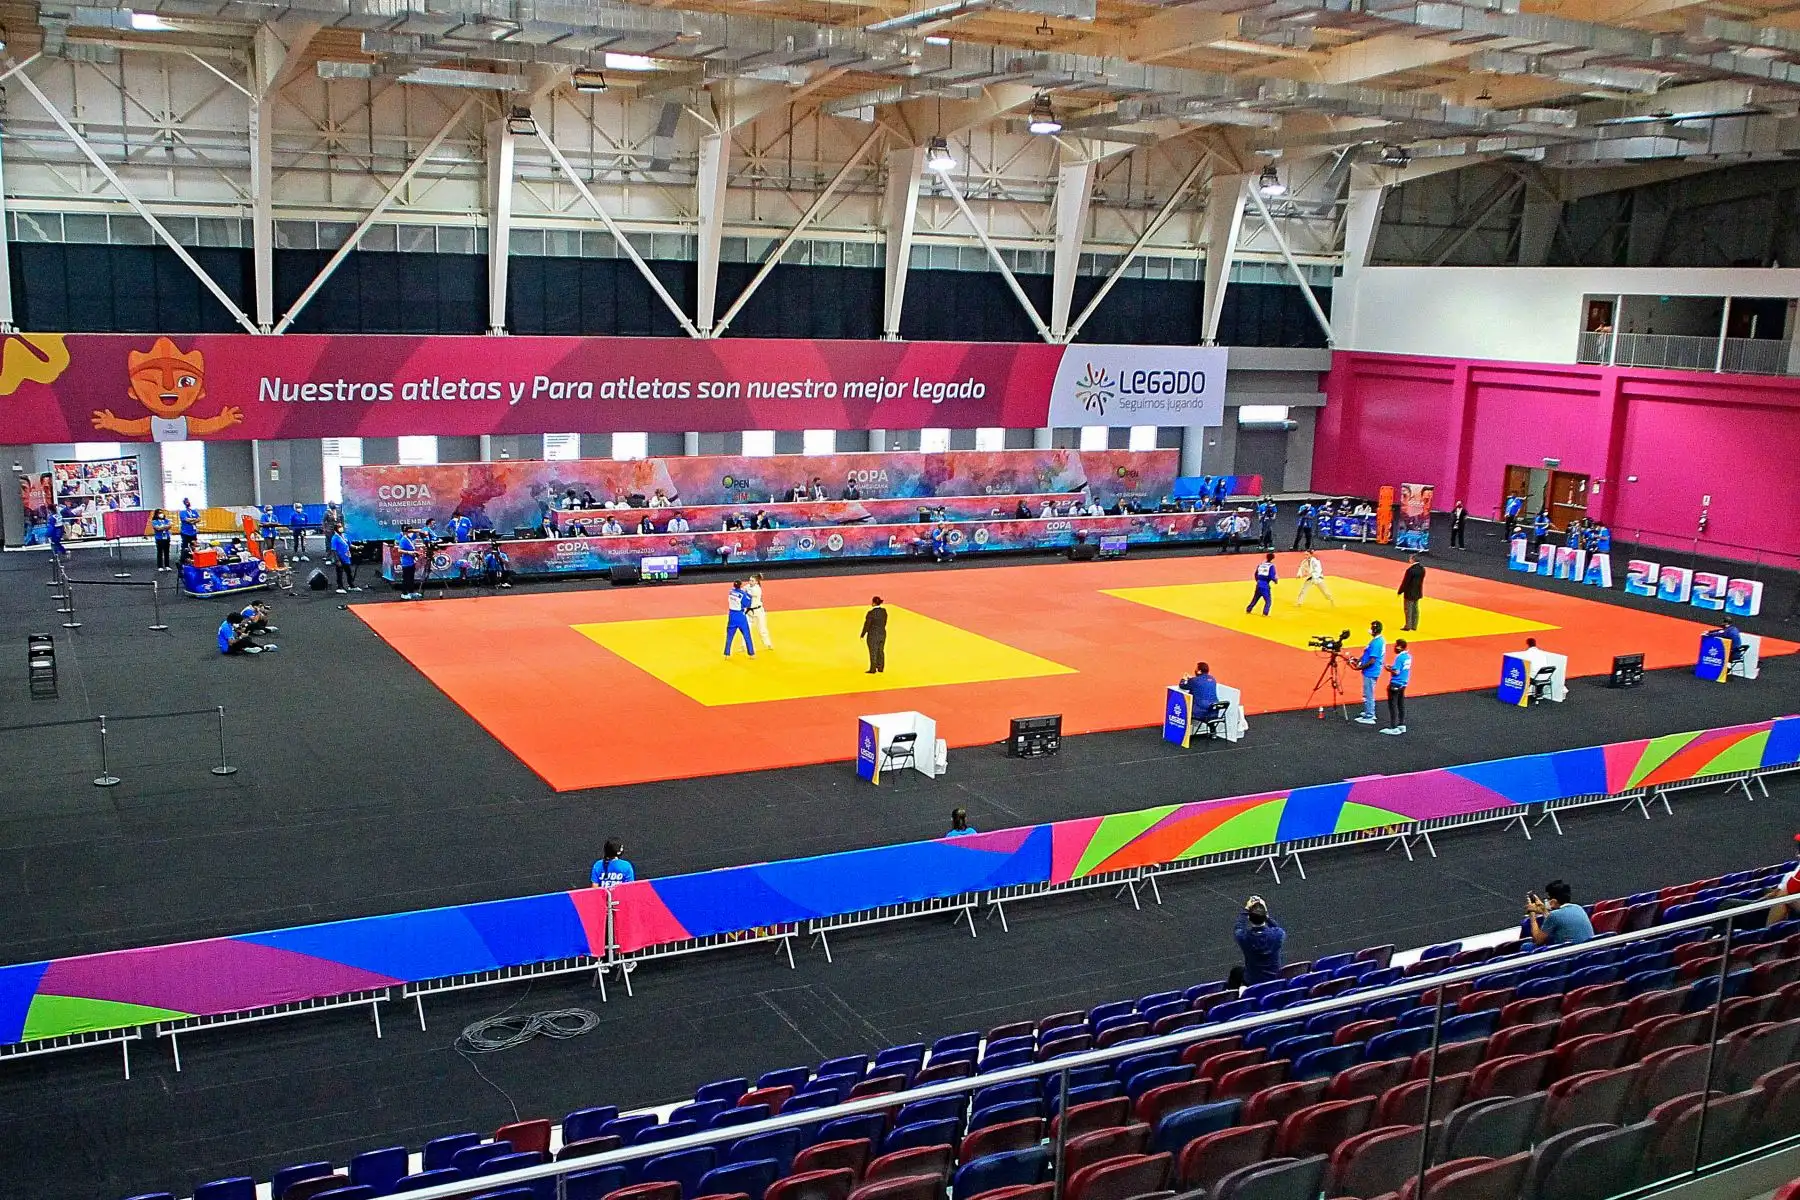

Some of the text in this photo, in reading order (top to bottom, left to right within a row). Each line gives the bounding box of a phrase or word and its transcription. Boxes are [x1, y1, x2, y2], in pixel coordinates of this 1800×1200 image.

[259, 375, 986, 406] Nuestros atletas y Para atletas son nuestro mejor legado
[1119, 398, 1204, 413] Seguimos jugando
[847, 470, 889, 483] COPA
[378, 484, 432, 500] COPA
[379, 500, 432, 508] PANAMERICANA
[1046, 522, 1072, 531] COPA
[556, 541, 590, 552] COPA
[1508, 539, 1612, 588] LIMA
[1624, 560, 1764, 617] 2020
